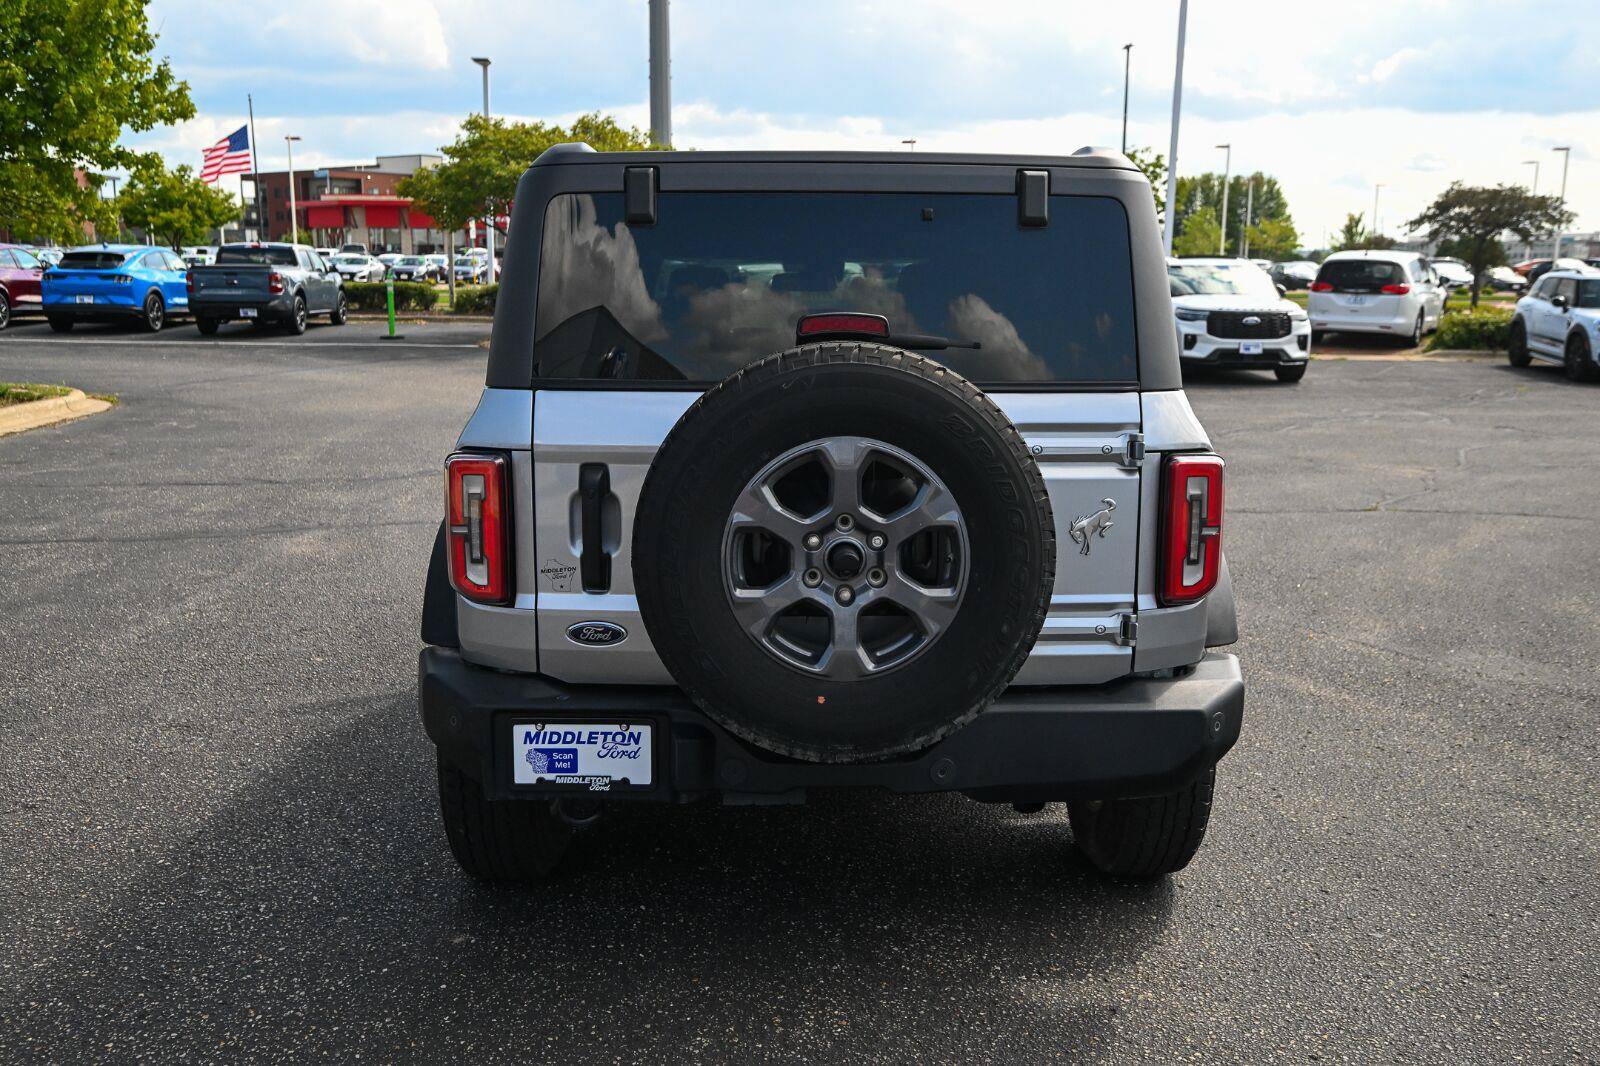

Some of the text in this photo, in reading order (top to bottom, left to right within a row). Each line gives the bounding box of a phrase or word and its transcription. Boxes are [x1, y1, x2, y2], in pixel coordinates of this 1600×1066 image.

[541, 566, 577, 574] MIDDLETON
[552, 572, 567, 580] Ford
[580, 626, 612, 640] Ford
[523, 730, 641, 745] MIDDLETON
[597, 741, 642, 759] Ford
[554, 761, 571, 769] Me!
[555, 776, 610, 784] MIDDLETON
[589, 782, 611, 791] Ford
